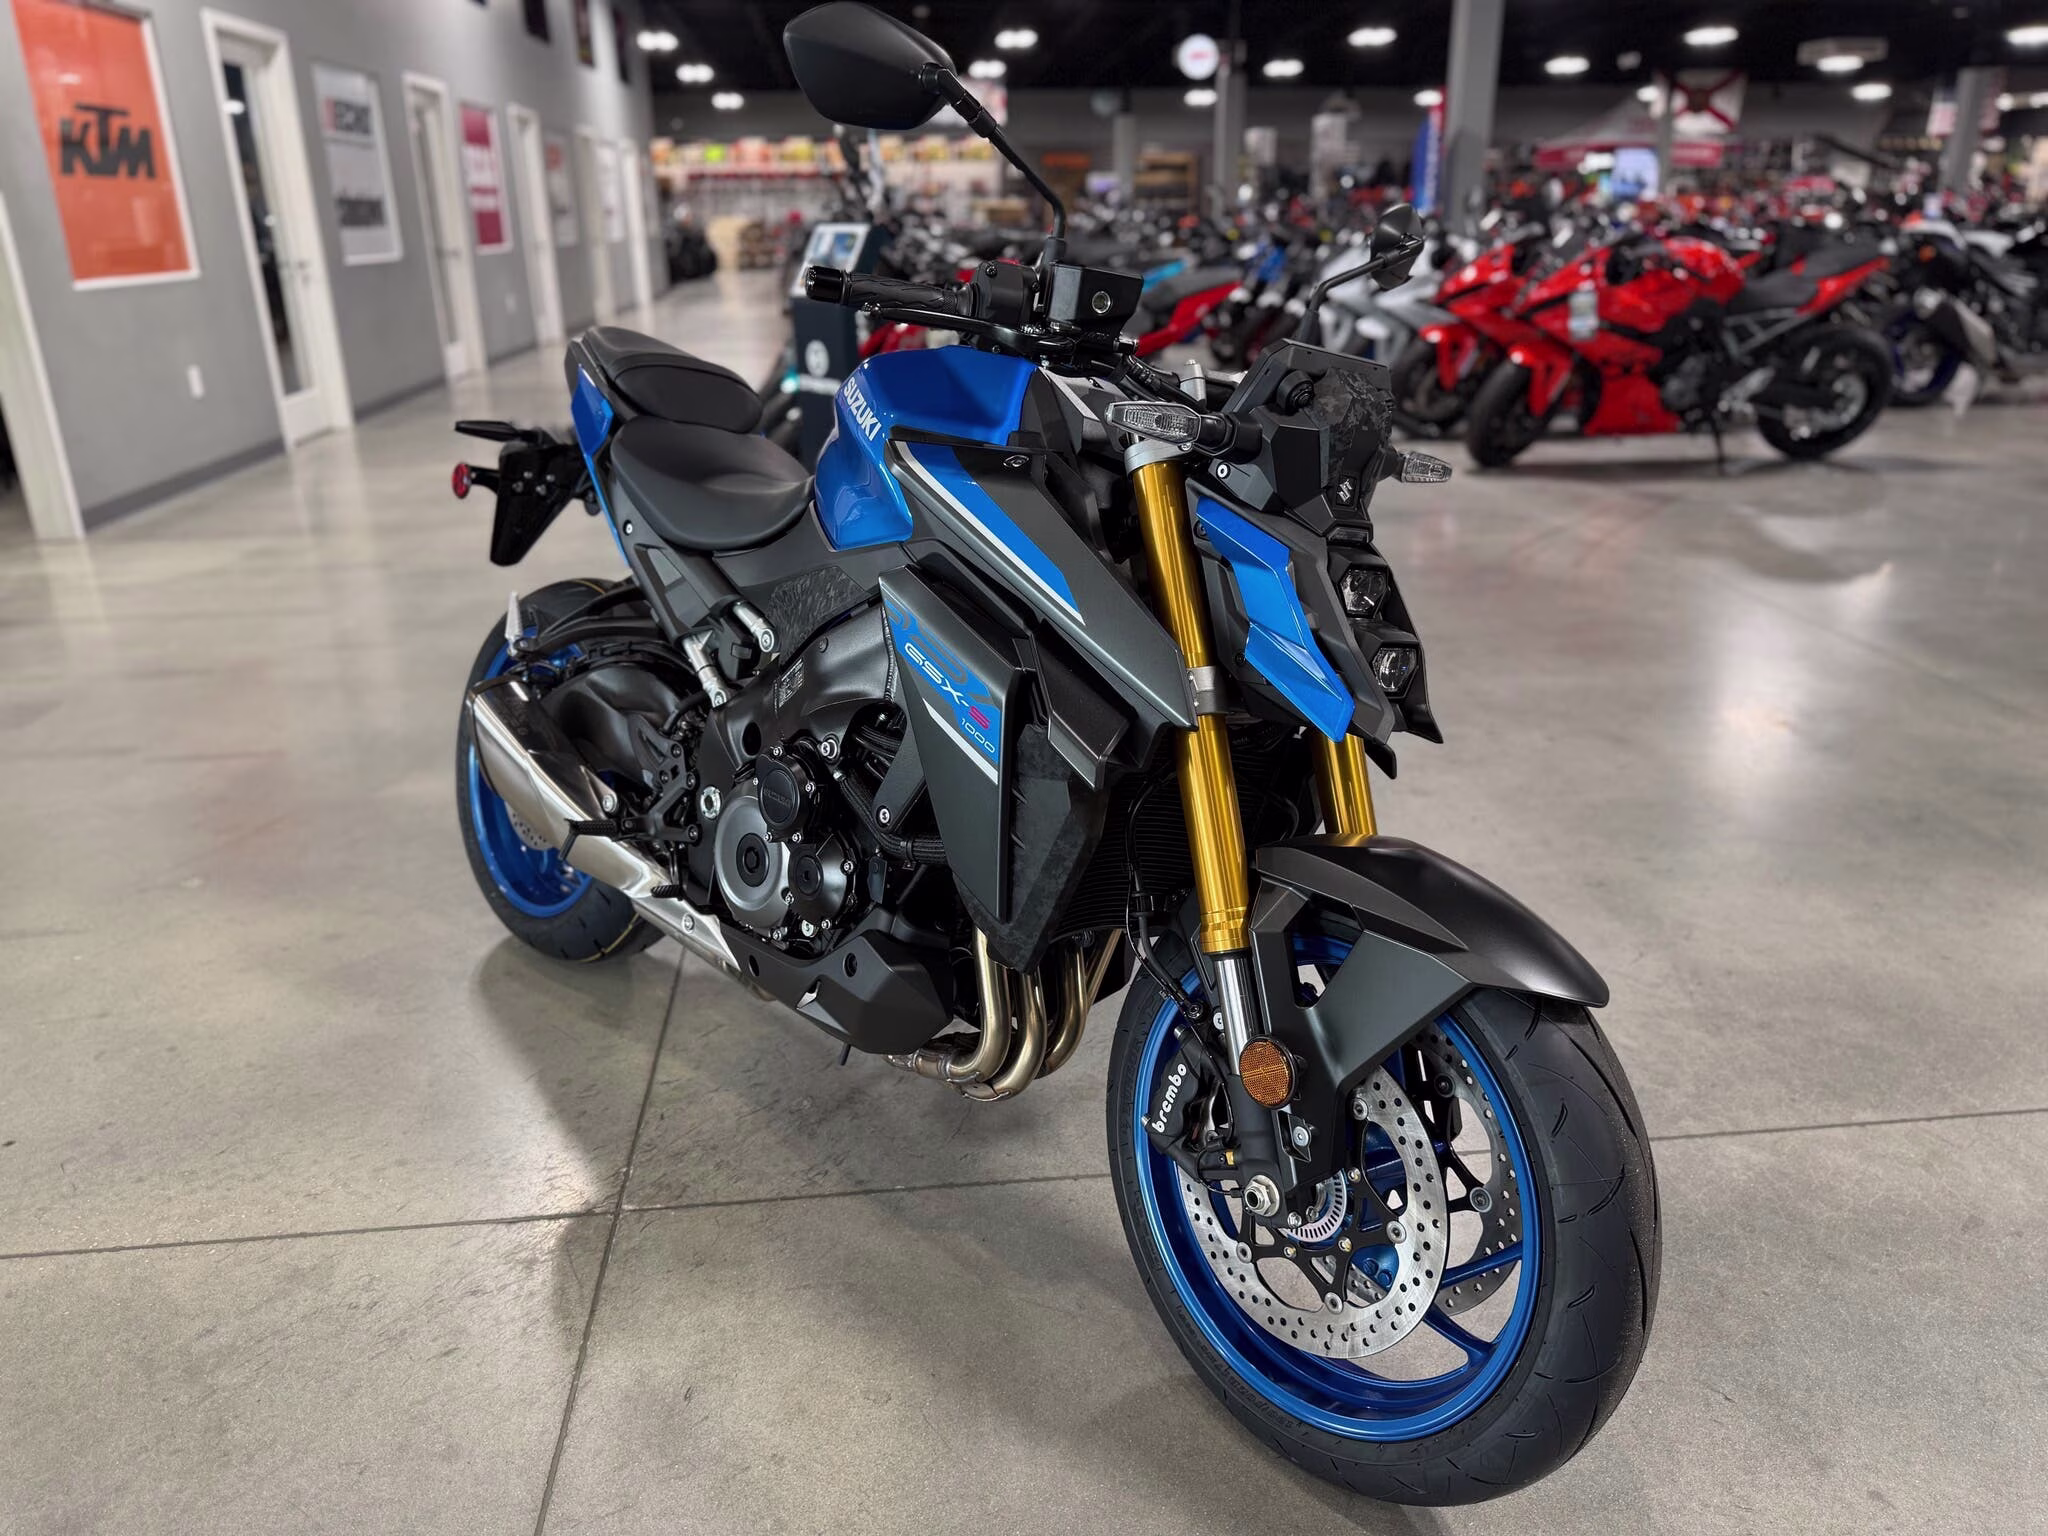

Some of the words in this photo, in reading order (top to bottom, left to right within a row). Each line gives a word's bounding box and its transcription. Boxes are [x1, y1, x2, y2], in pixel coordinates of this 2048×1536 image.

[60, 102, 156, 179] KTM
[843, 376, 882, 442] SUZUKI
[904, 642, 991, 730] GSX-S
[961, 717, 996, 753] 1000
[1151, 1063, 1187, 1133] brembo
